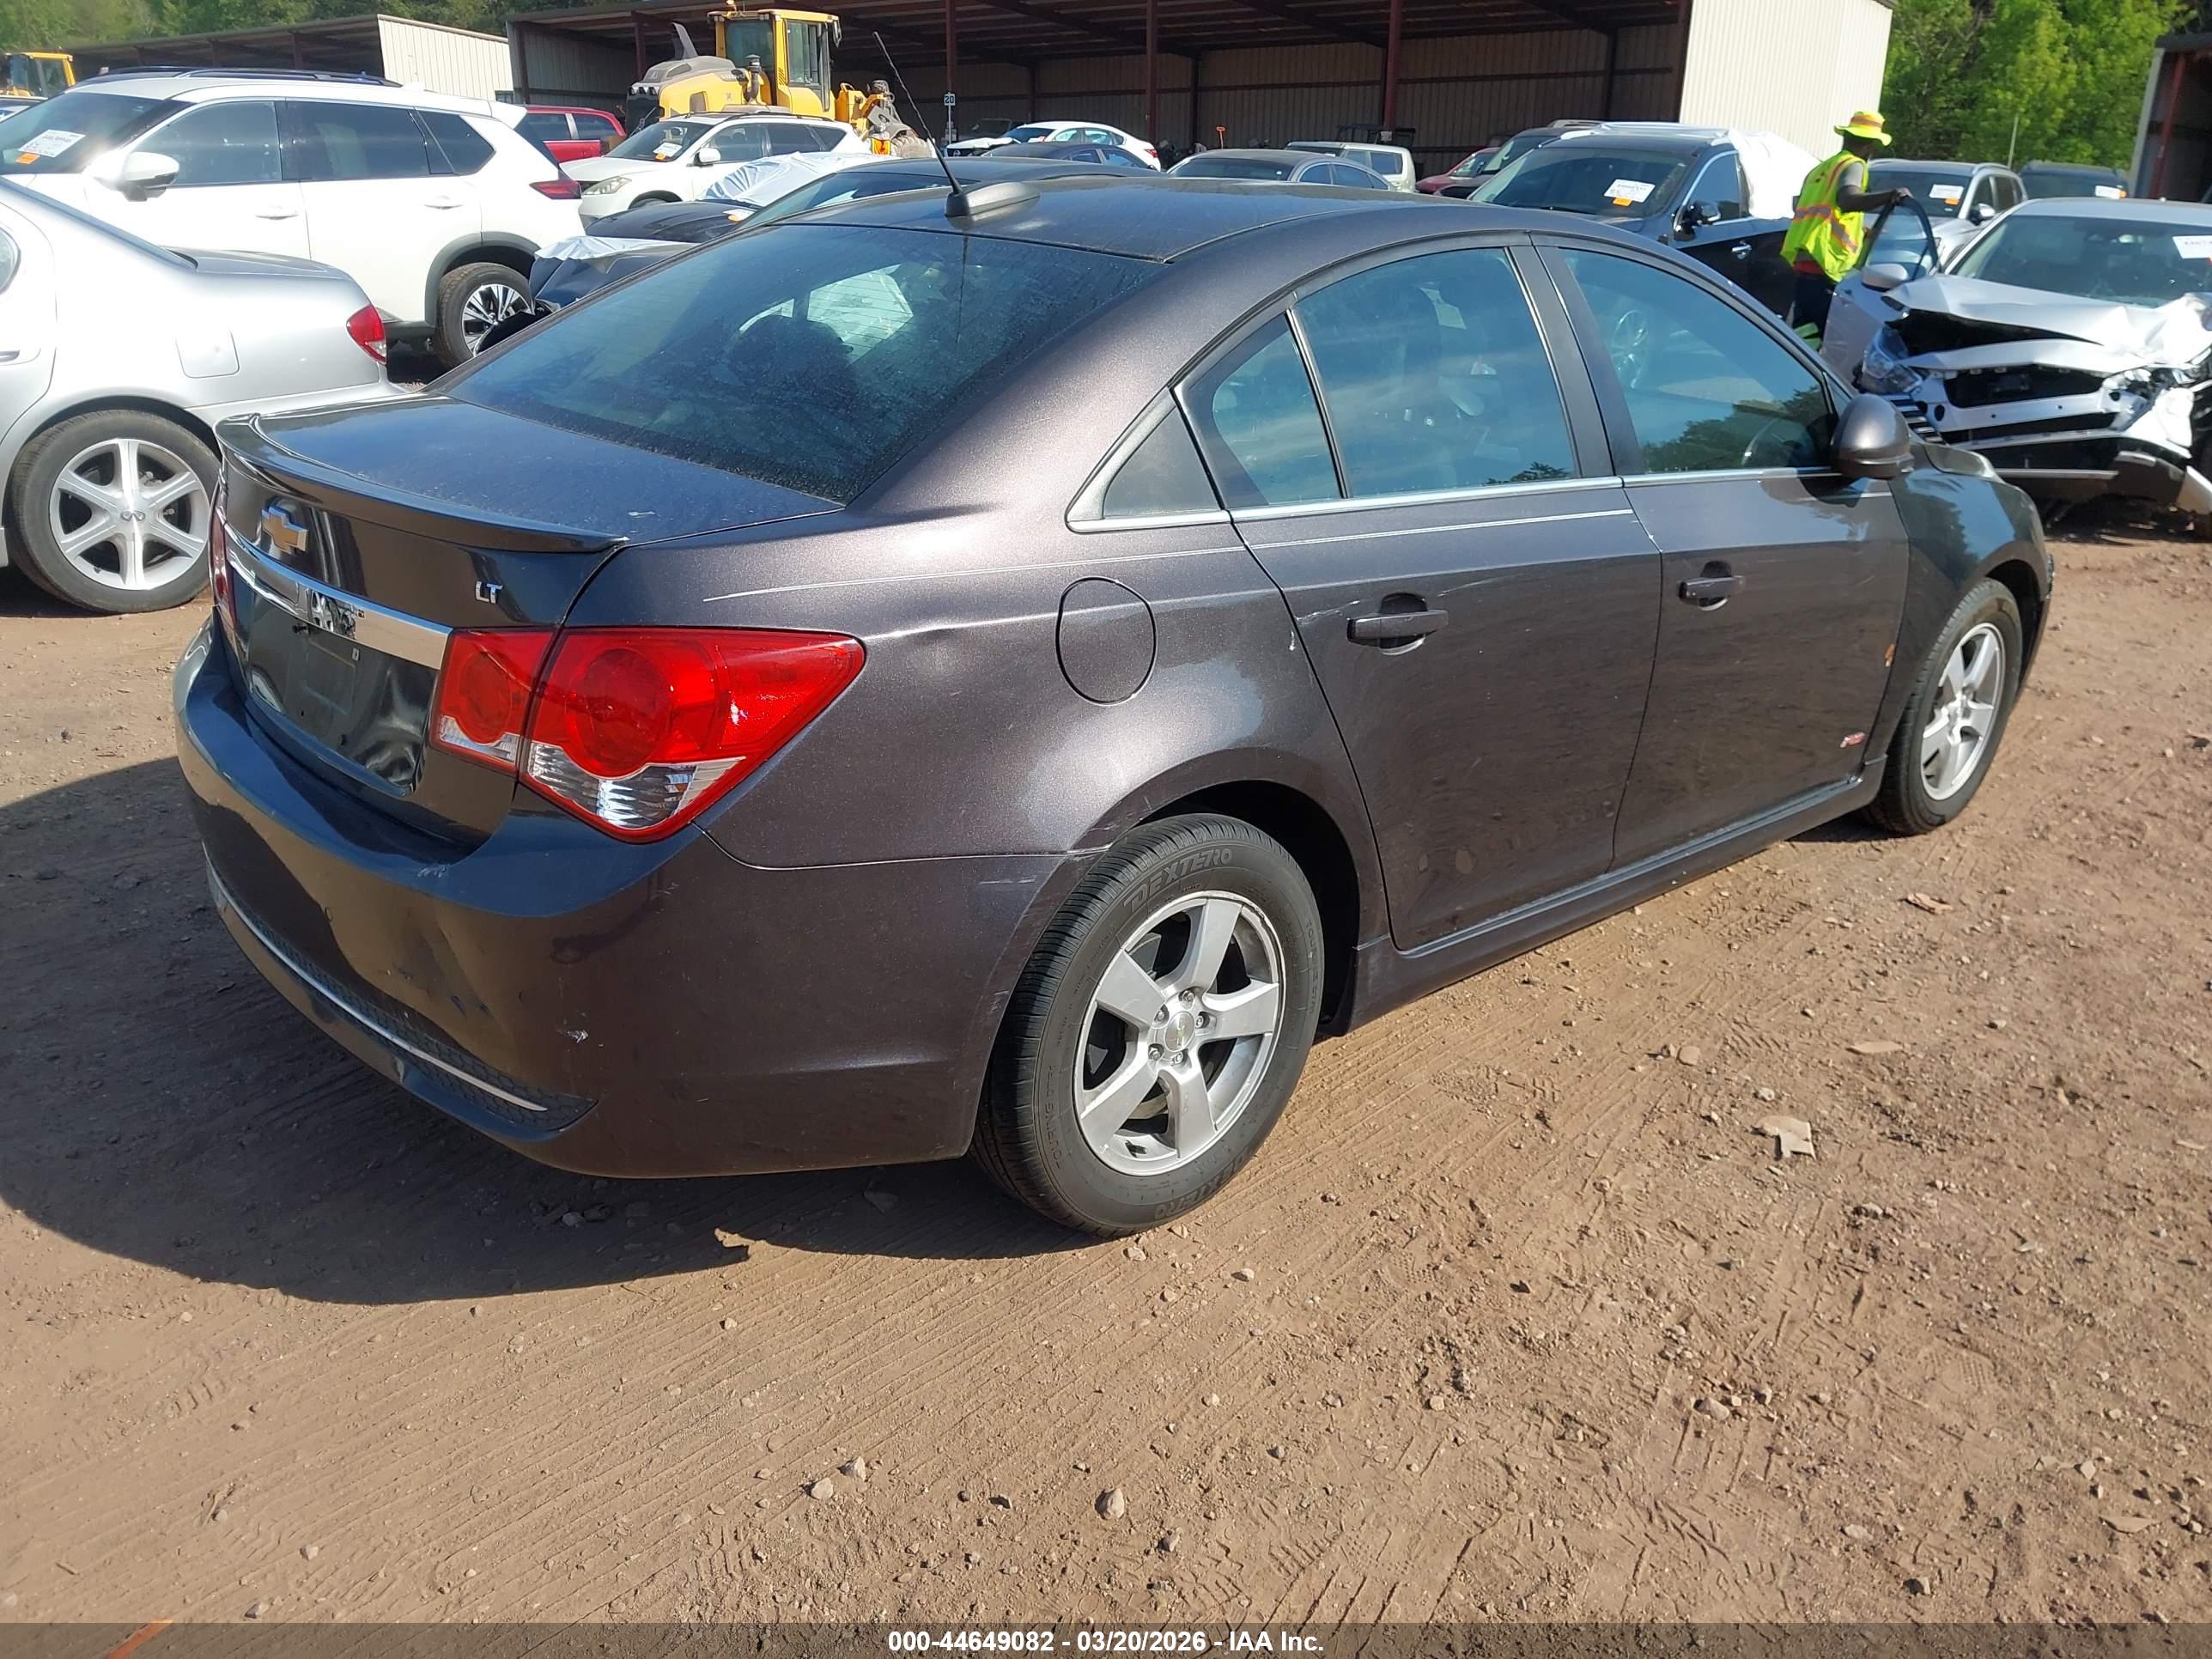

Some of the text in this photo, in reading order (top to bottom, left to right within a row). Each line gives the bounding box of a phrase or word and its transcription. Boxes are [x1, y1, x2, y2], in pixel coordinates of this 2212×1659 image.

[945, 95, 955, 104] 20
[476, 580, 503, 604] LT
[1123, 848, 1232, 914] DEXTERO
